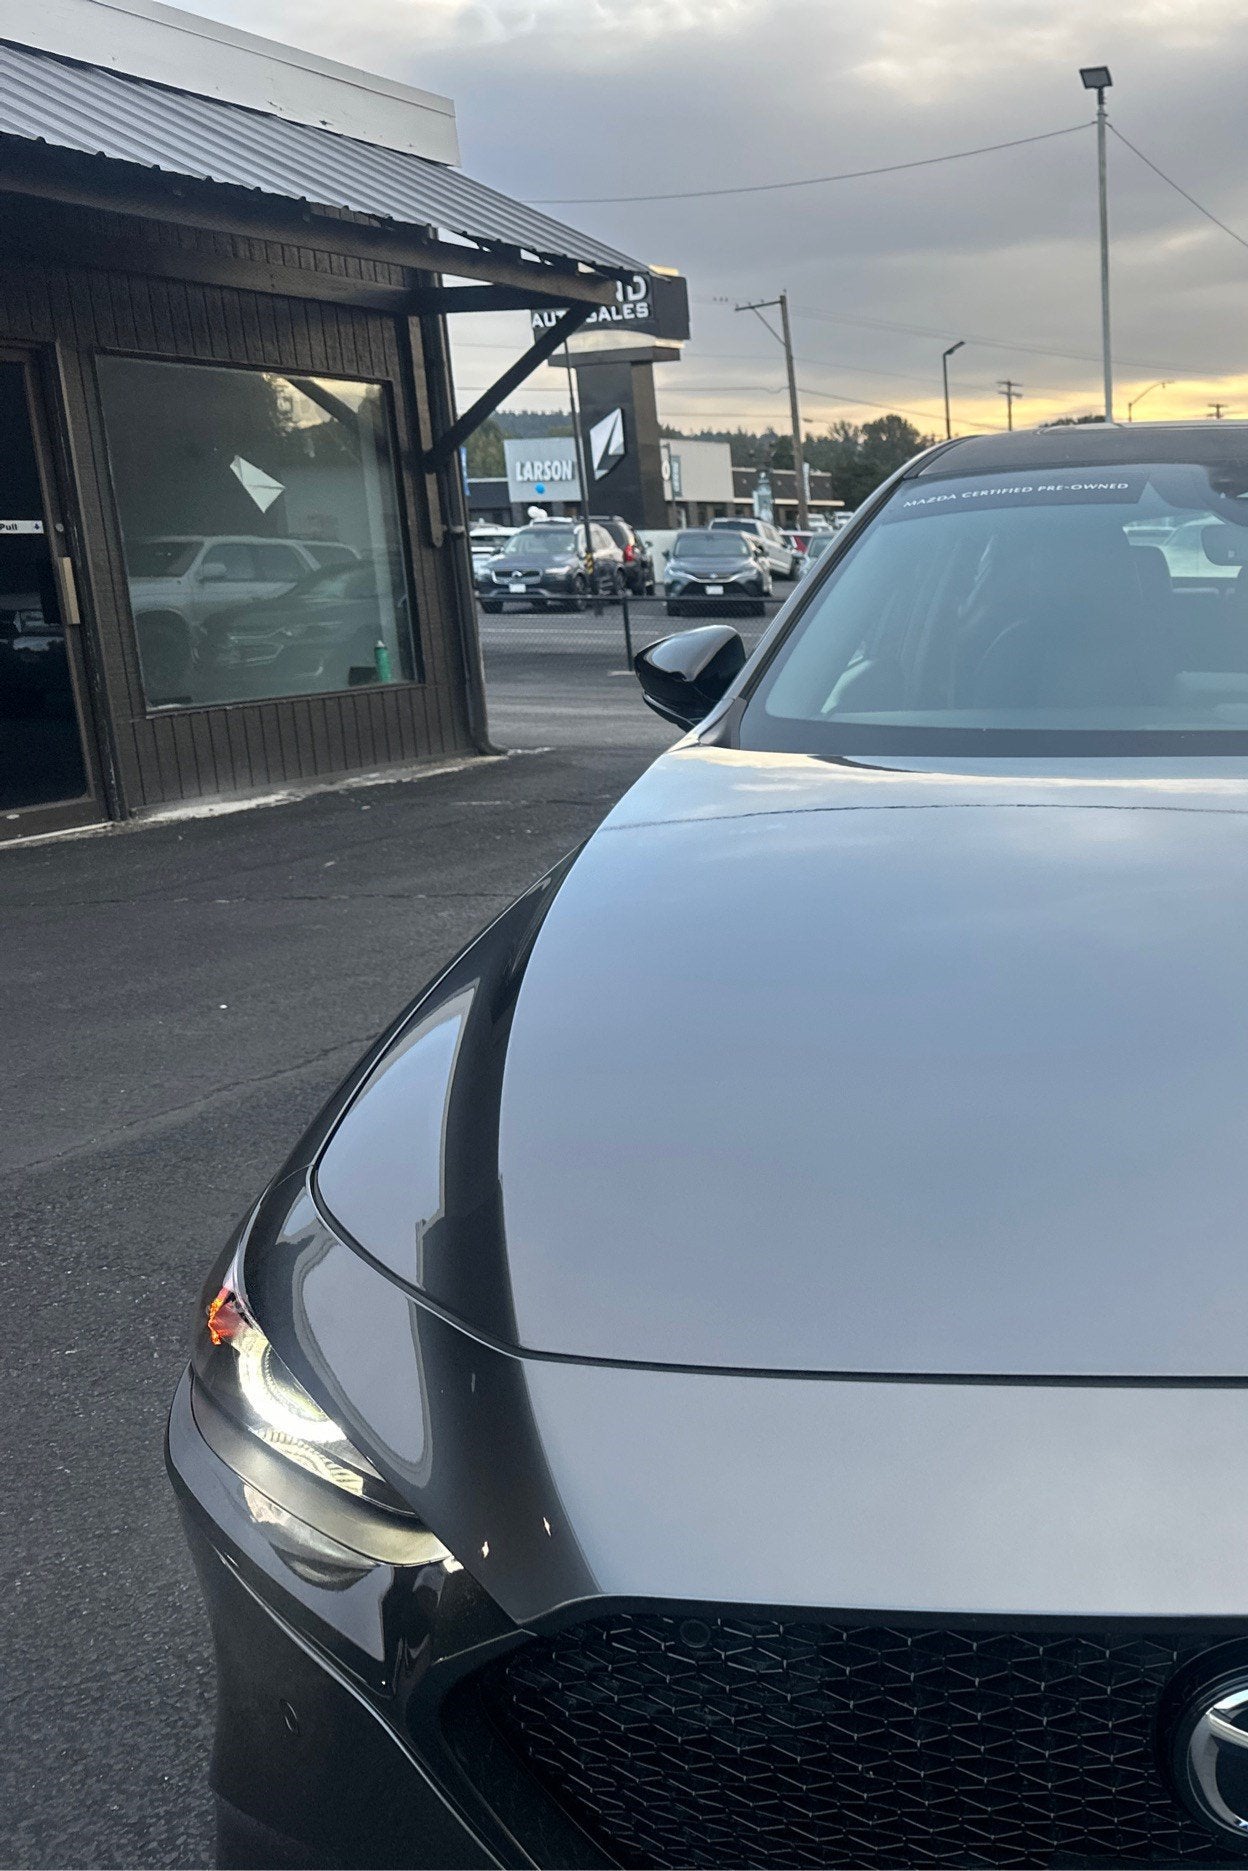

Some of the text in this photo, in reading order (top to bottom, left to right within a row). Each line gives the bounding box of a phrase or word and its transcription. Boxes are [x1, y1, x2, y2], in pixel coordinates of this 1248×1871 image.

[515, 460, 573, 482] LARSON
[903, 483, 1129, 508] MAZDA CERTIFIED PRE-OWNED
